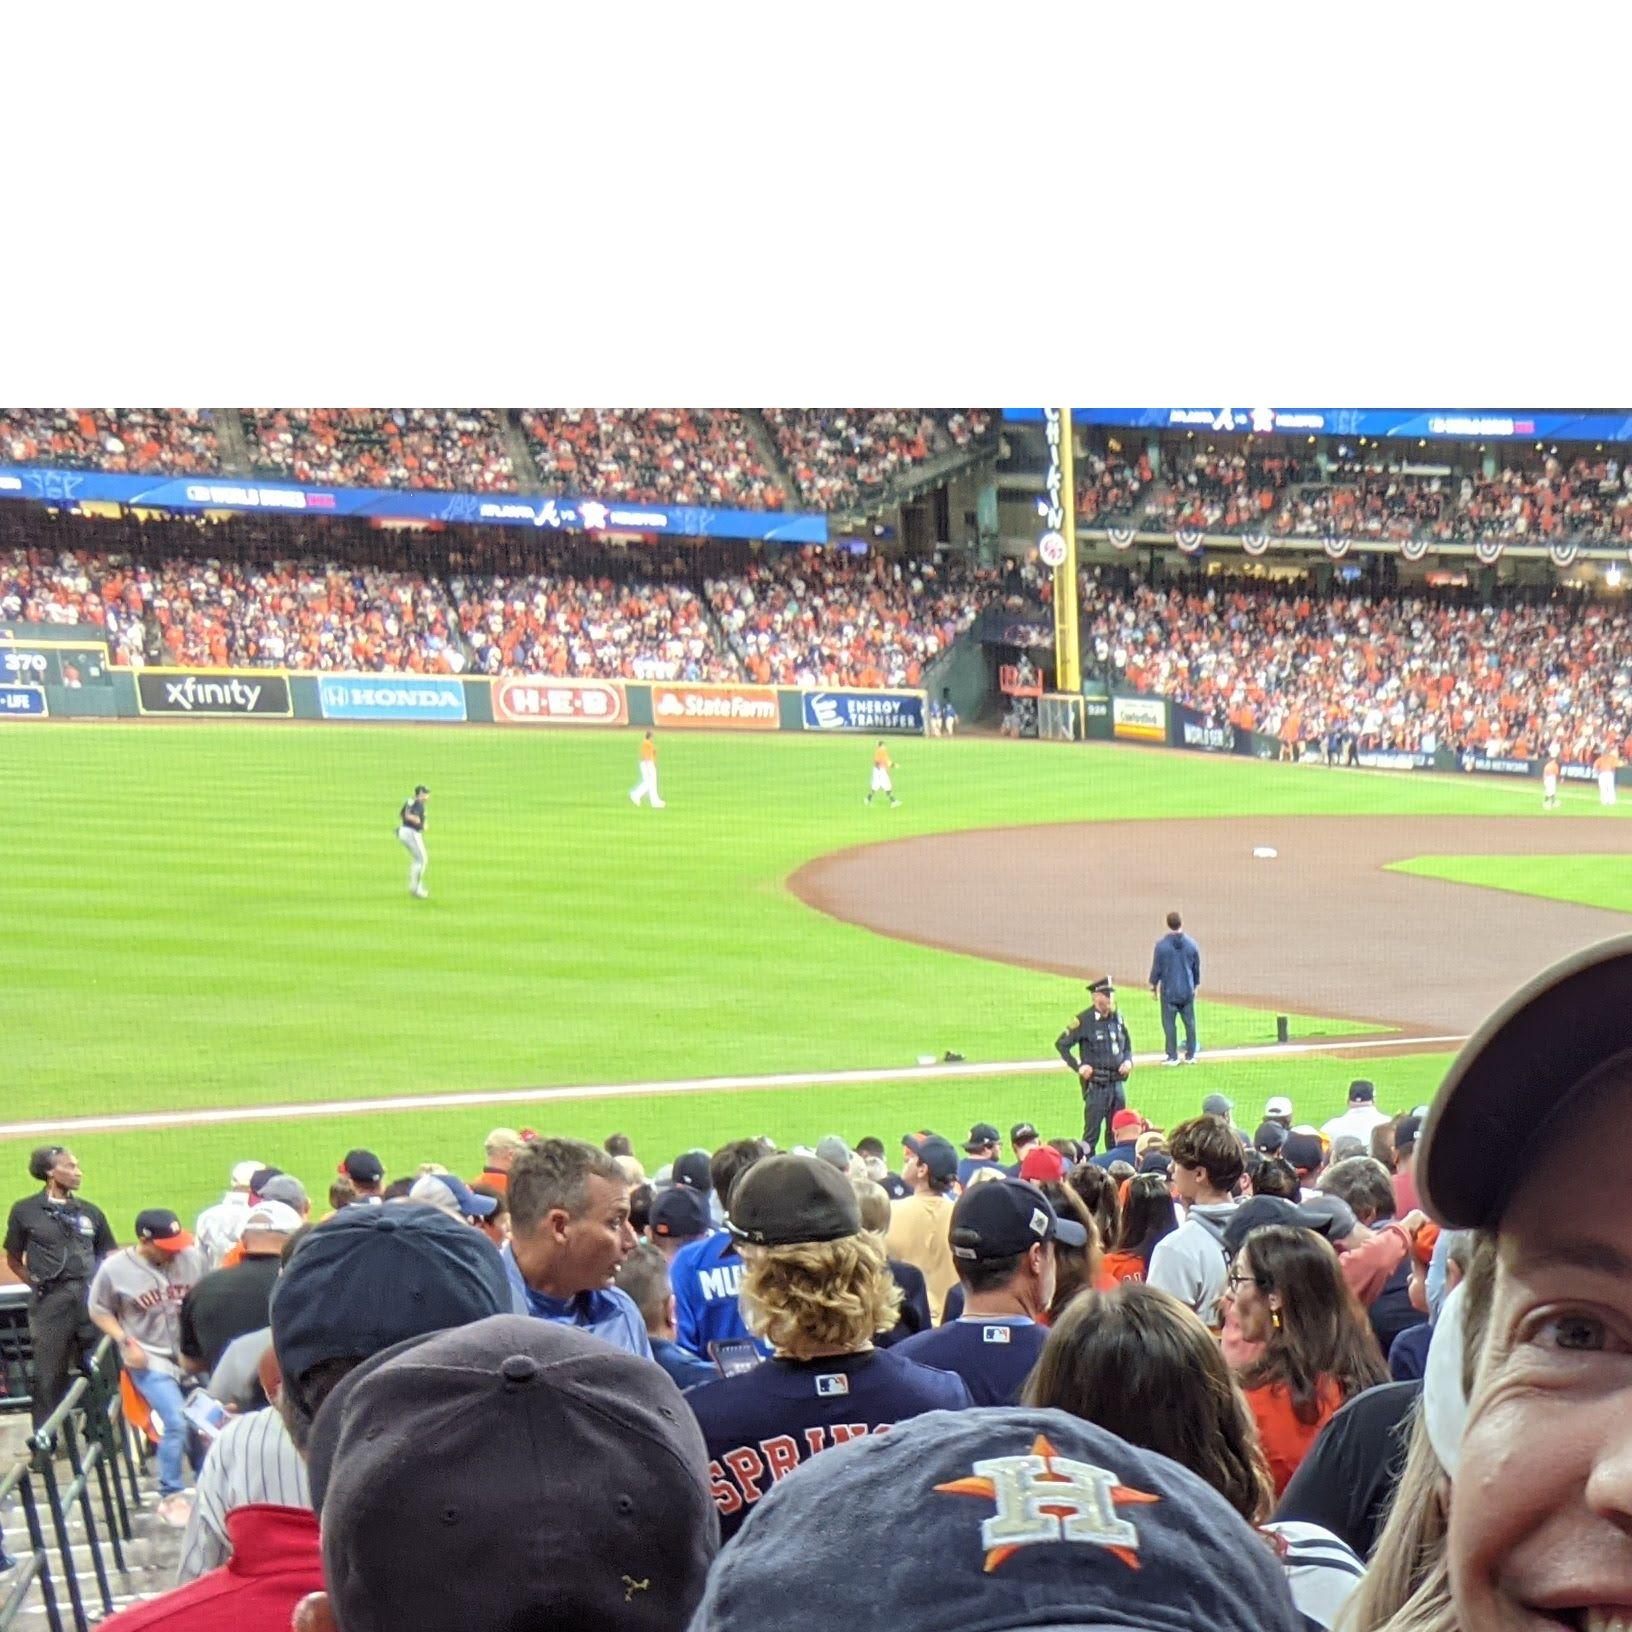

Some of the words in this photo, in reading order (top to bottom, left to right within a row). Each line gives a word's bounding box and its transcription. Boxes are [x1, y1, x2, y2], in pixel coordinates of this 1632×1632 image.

[166, 677, 262, 711] xfinity
[353, 688, 460, 707] HONDA
[848, 700, 900, 714] ENERGY
[850, 713, 916, 728] TRANSFER
[970, 1453, 1140, 1553] H
